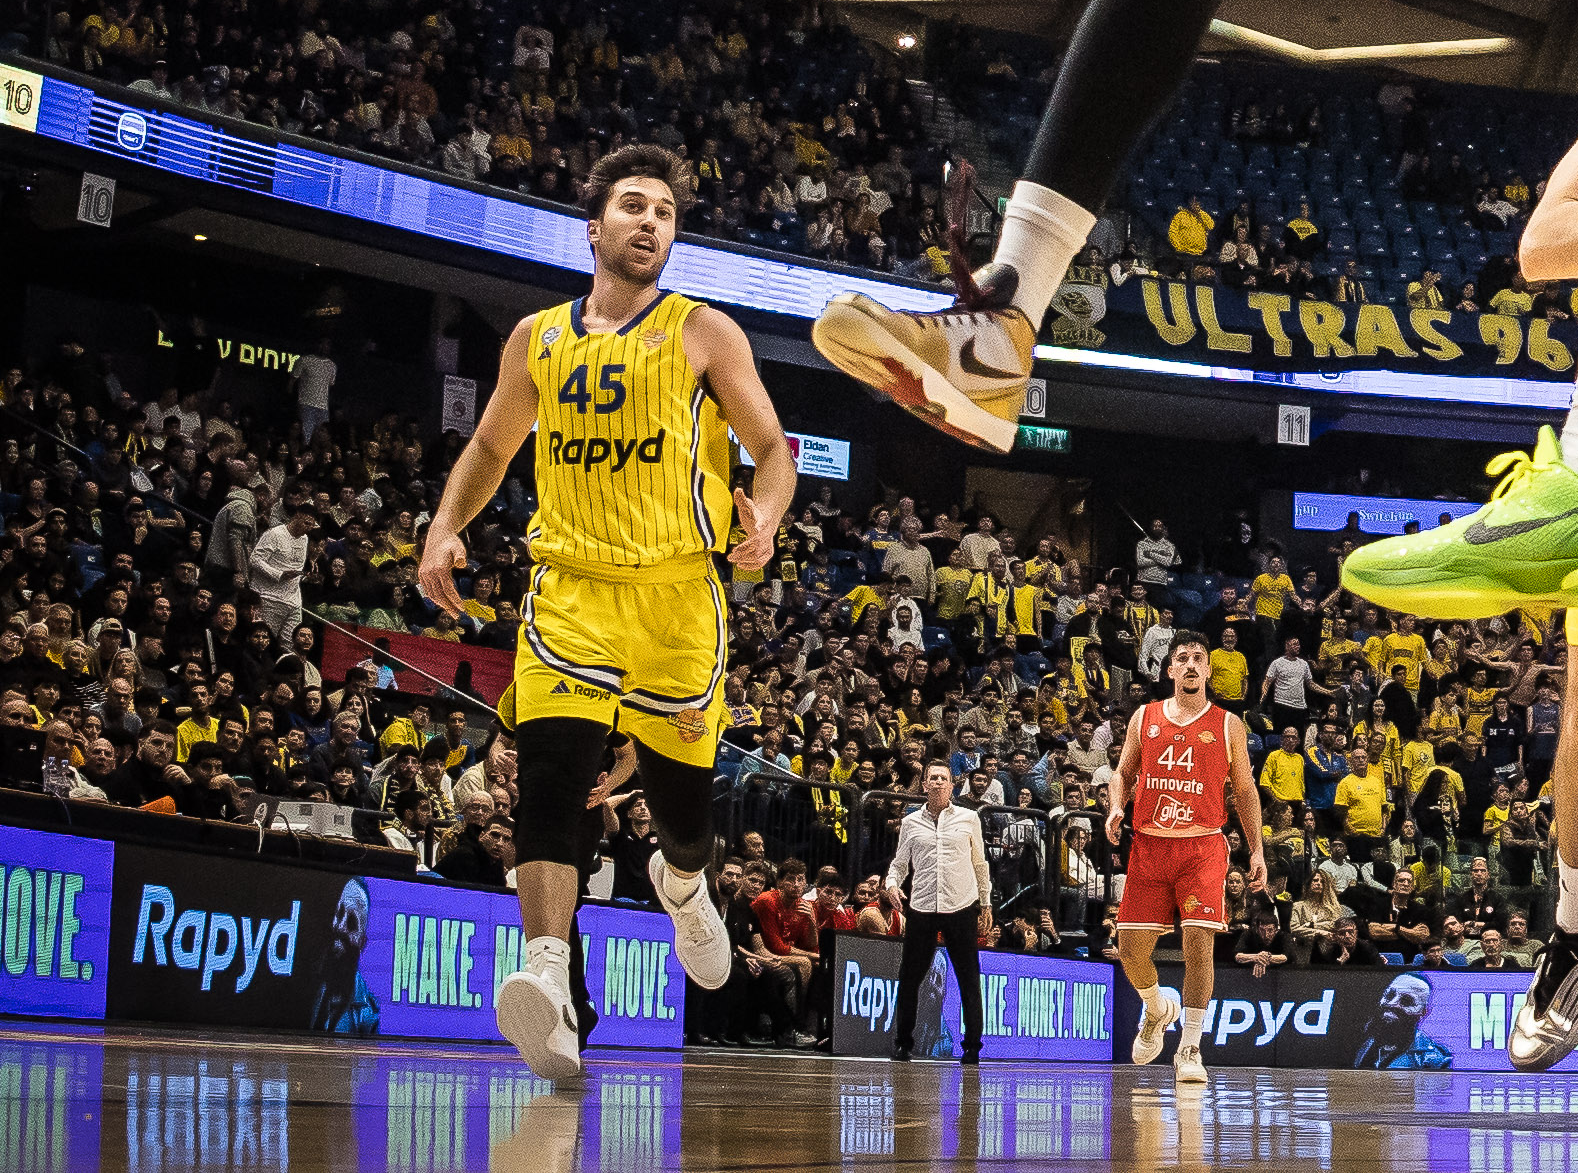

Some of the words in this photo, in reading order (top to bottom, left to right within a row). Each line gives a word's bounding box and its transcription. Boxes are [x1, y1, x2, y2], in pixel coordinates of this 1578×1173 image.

[3, 79, 33, 115] 10
[84, 182, 111, 222] 10
[1142, 278, 1467, 361] ULTRAS
[1478, 314, 1575, 371] 96
[557, 363, 627, 415] 45
[550, 428, 666, 472] Rapyd
[803, 439, 830, 452] Eldan
[1282, 412, 1308, 443] 11
[573, 684, 613, 701] Rapyd
[1157, 744, 1195, 773] 44
[1146, 773, 1204, 795] innovate
[0, 864, 93, 981] OVE.
[132, 883, 301, 993] Rapyd
[392, 913, 482, 1008] MAKE.
[604, 936, 675, 1020] MOVE.
[842, 960, 900, 1033] Rapy
[960, 973, 1012, 1037] AKE.
[1017, 976, 1068, 1039] MONEY.
[1072, 981, 1110, 1040] MOVE.
